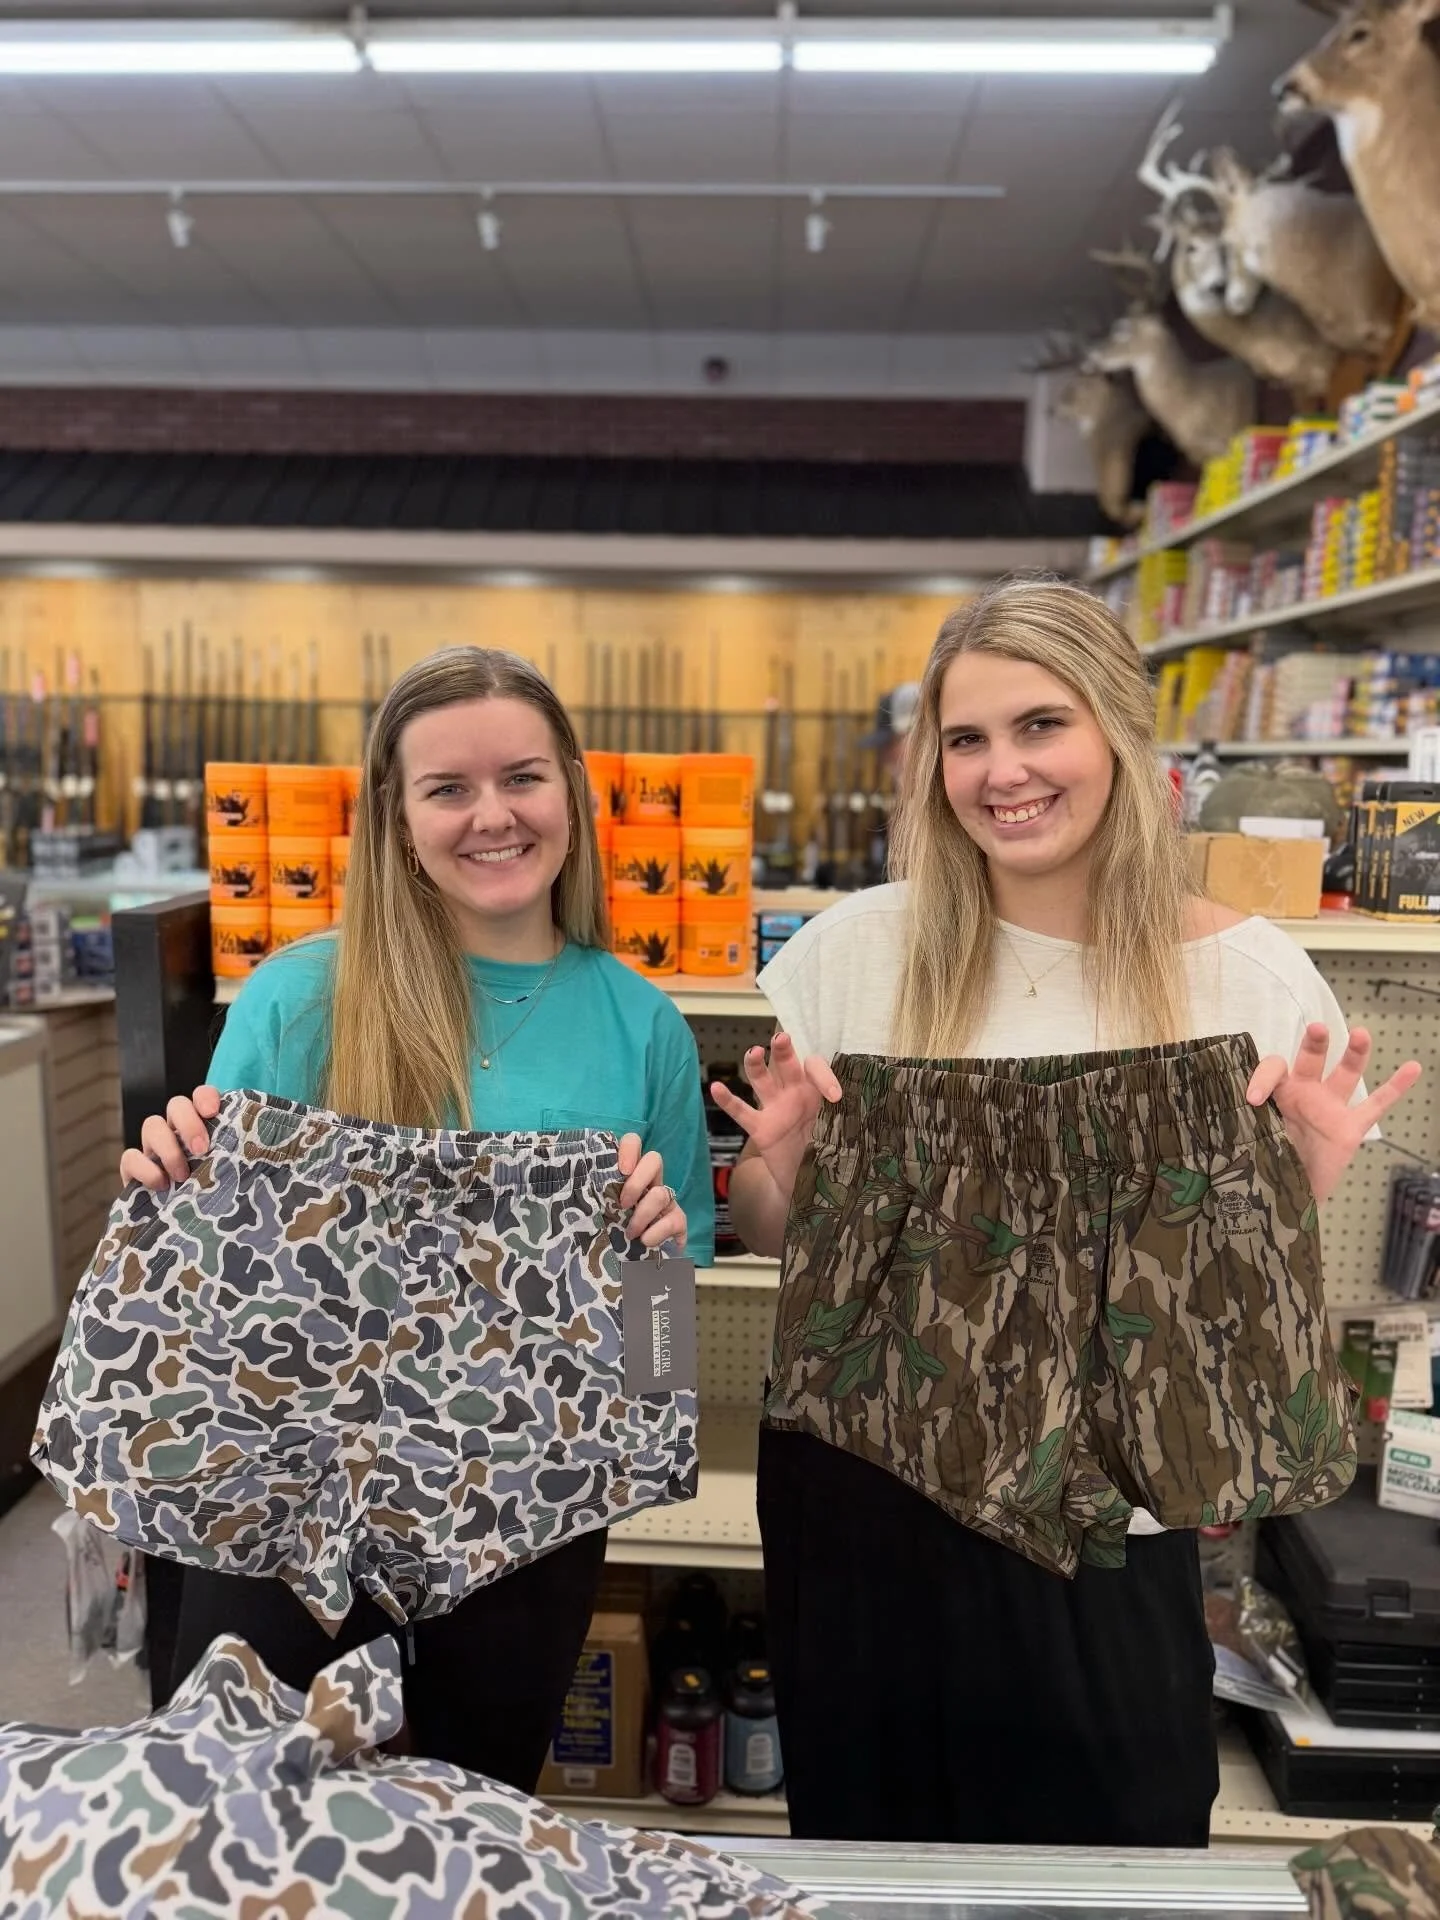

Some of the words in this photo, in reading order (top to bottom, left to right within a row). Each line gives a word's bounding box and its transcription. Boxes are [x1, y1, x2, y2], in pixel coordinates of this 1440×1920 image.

[1402, 808, 1426, 827] NEW
[660, 1310, 671, 1348] LOCAL
[652, 1311, 661, 1376] OUTFITTERS
[661, 1349, 672, 1376] GIRL
[1387, 1467, 1430, 1486] MODEL
